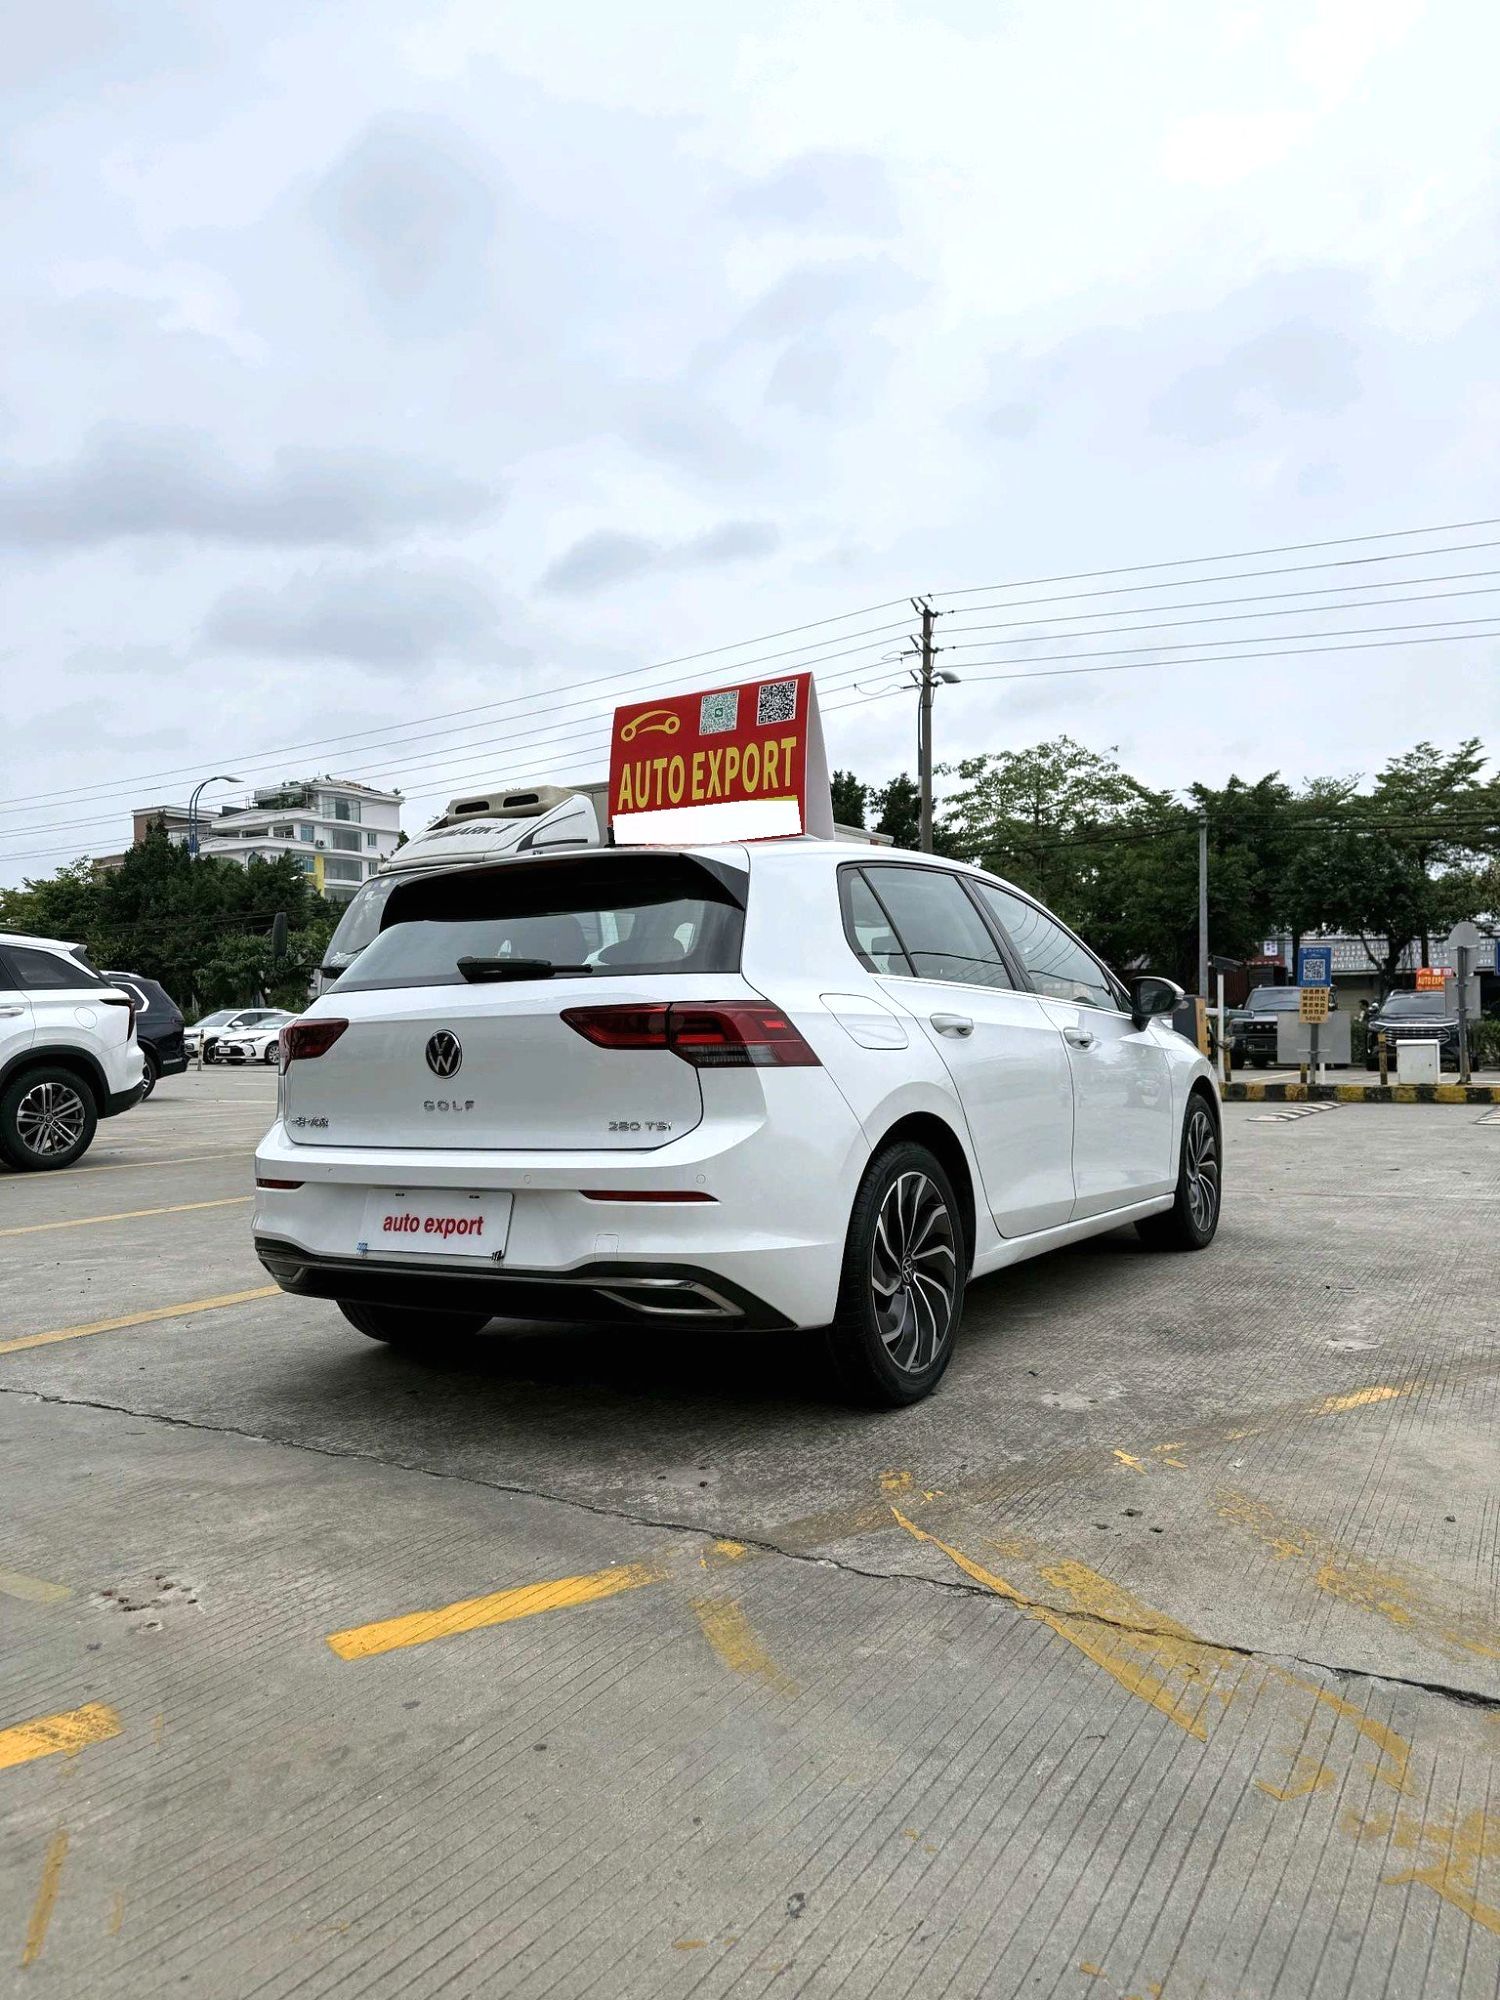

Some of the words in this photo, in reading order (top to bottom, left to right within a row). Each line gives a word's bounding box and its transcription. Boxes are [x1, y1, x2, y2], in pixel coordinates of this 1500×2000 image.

[617, 754, 686, 811] AUTO
[691, 735, 797, 801] EXPORT
[1417, 975, 1431, 986] AUTO
[423, 1100, 475, 1112] GOLF
[382, 1213, 420, 1233] auto
[423, 1216, 484, 1240] export
